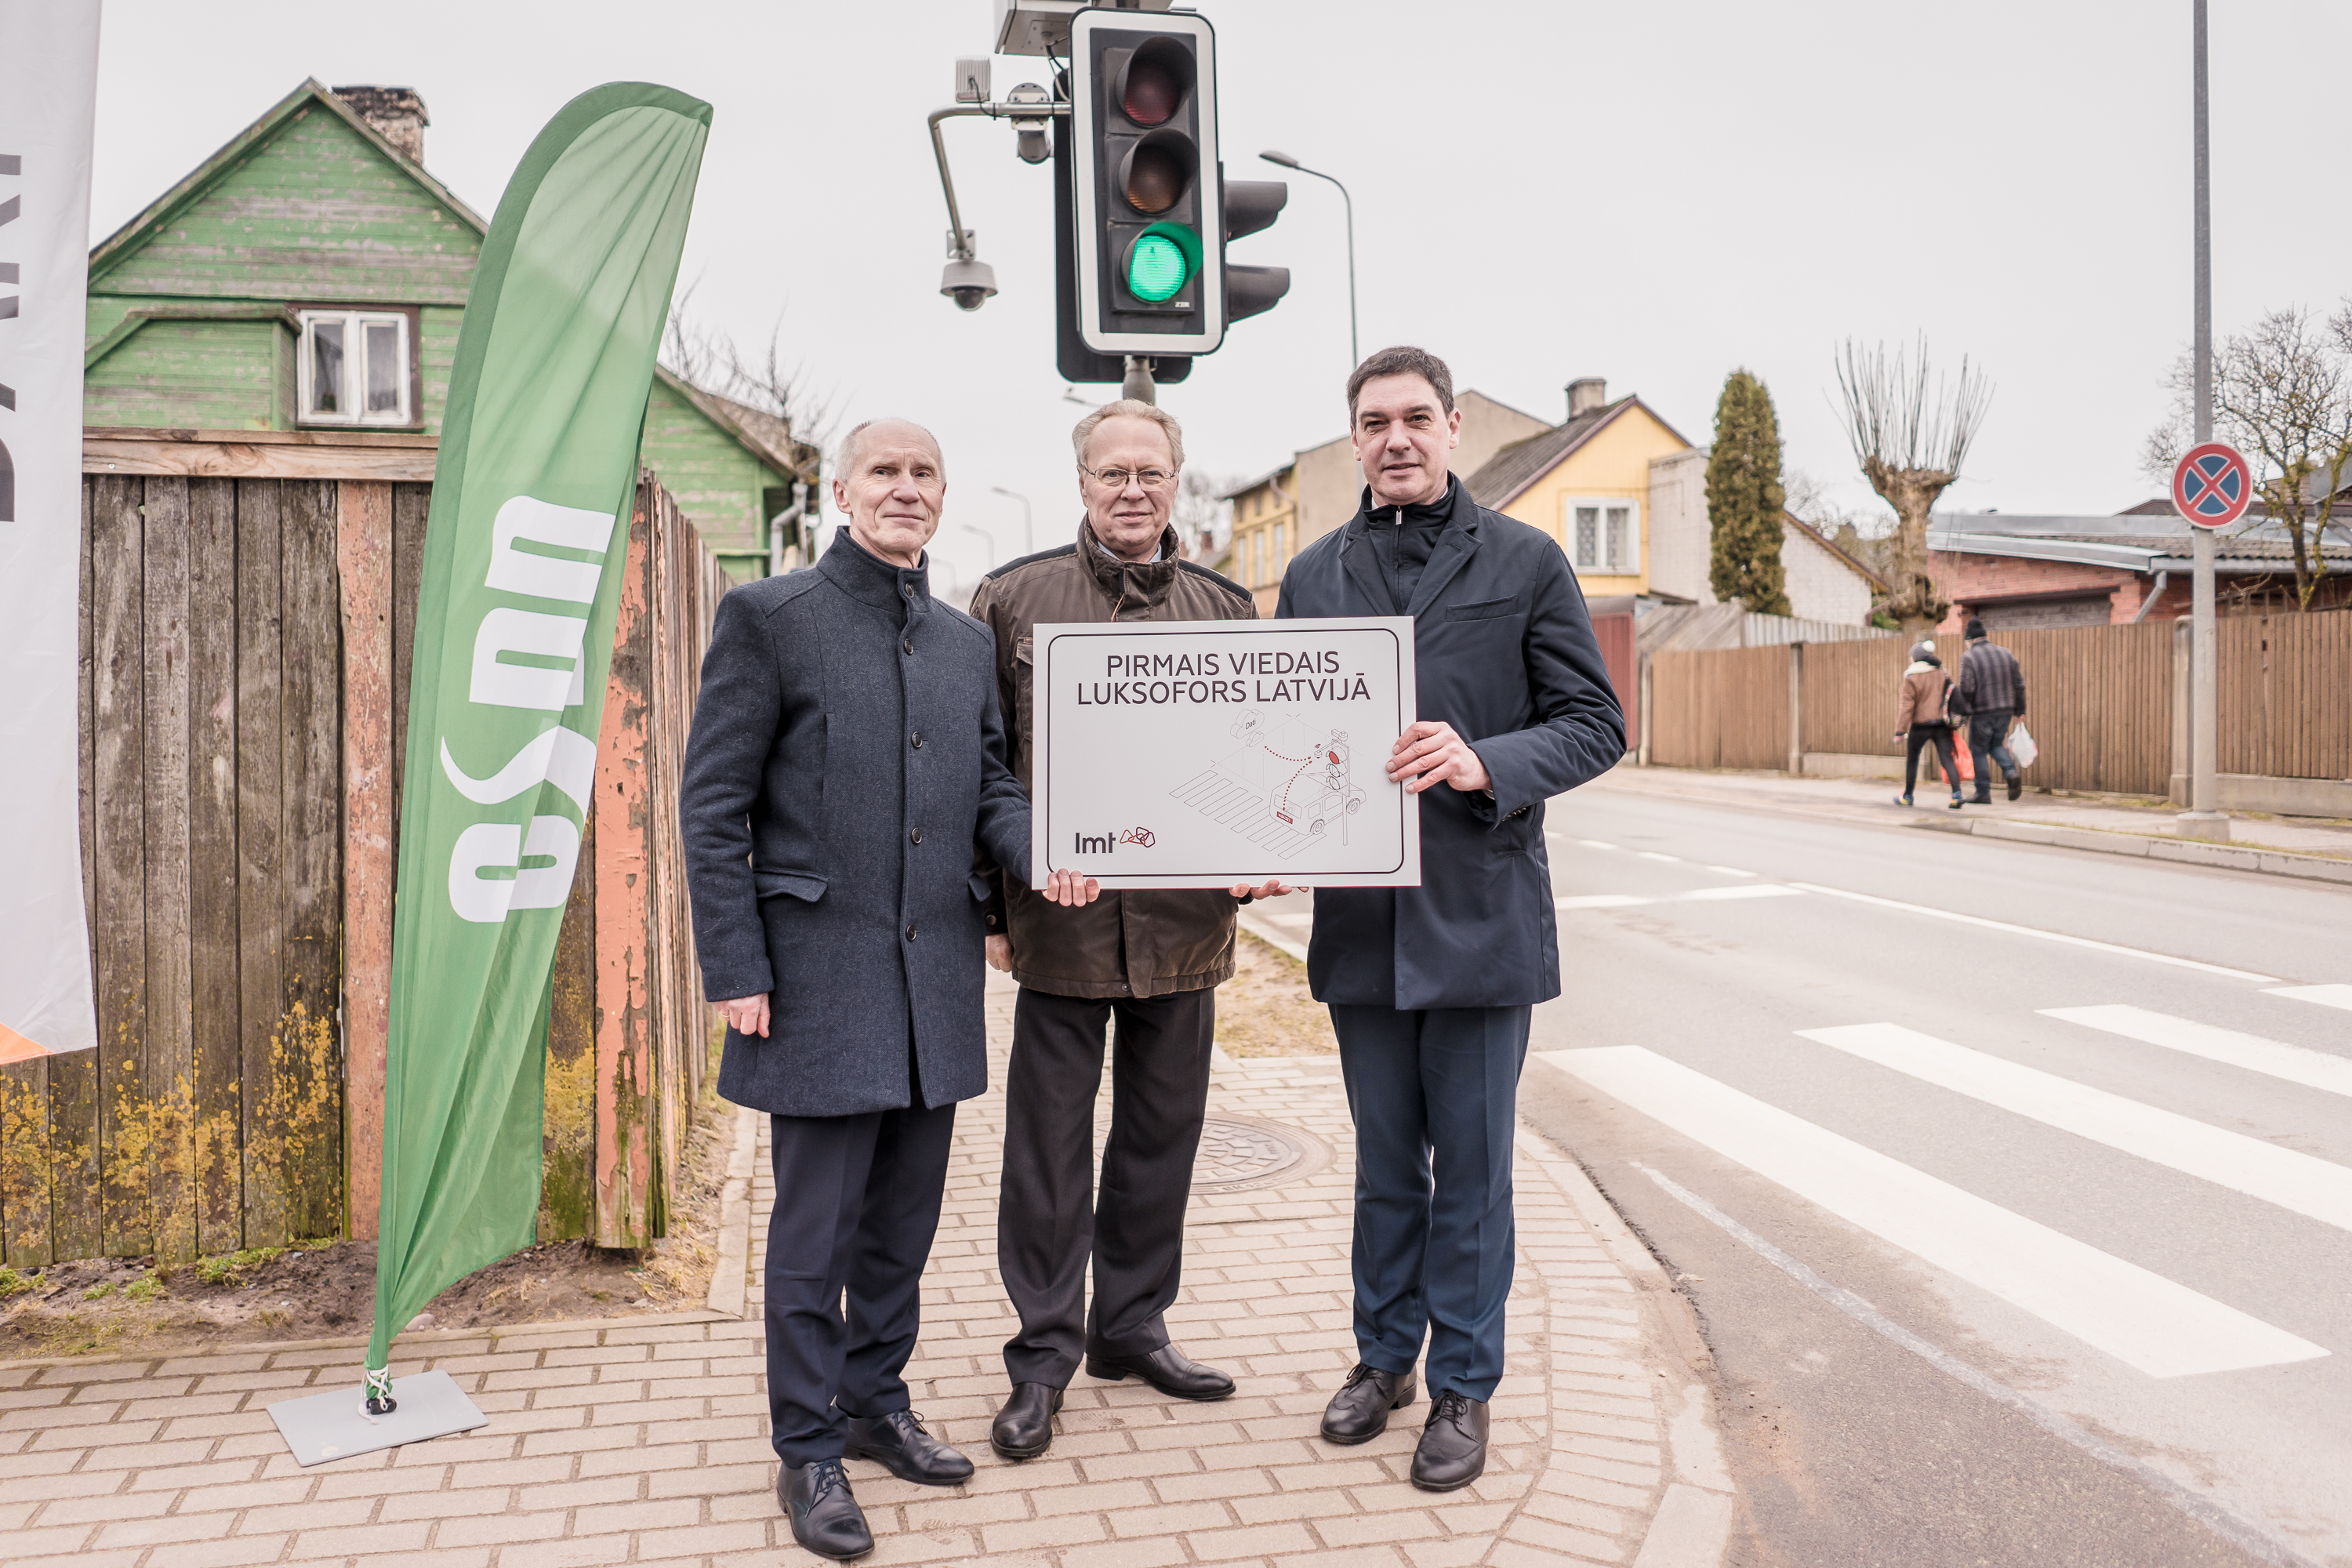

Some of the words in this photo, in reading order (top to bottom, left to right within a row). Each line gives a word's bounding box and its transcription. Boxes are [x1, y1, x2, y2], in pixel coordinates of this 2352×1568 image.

[1107, 652, 1220, 677] PIRMAIS
[1229, 651, 1340, 676] VIEDAIS
[1078, 680, 1247, 706] LUKSOFORS
[1256, 672, 1371, 702] LATVIJĀ
[1245, 717, 1256, 730] Dati
